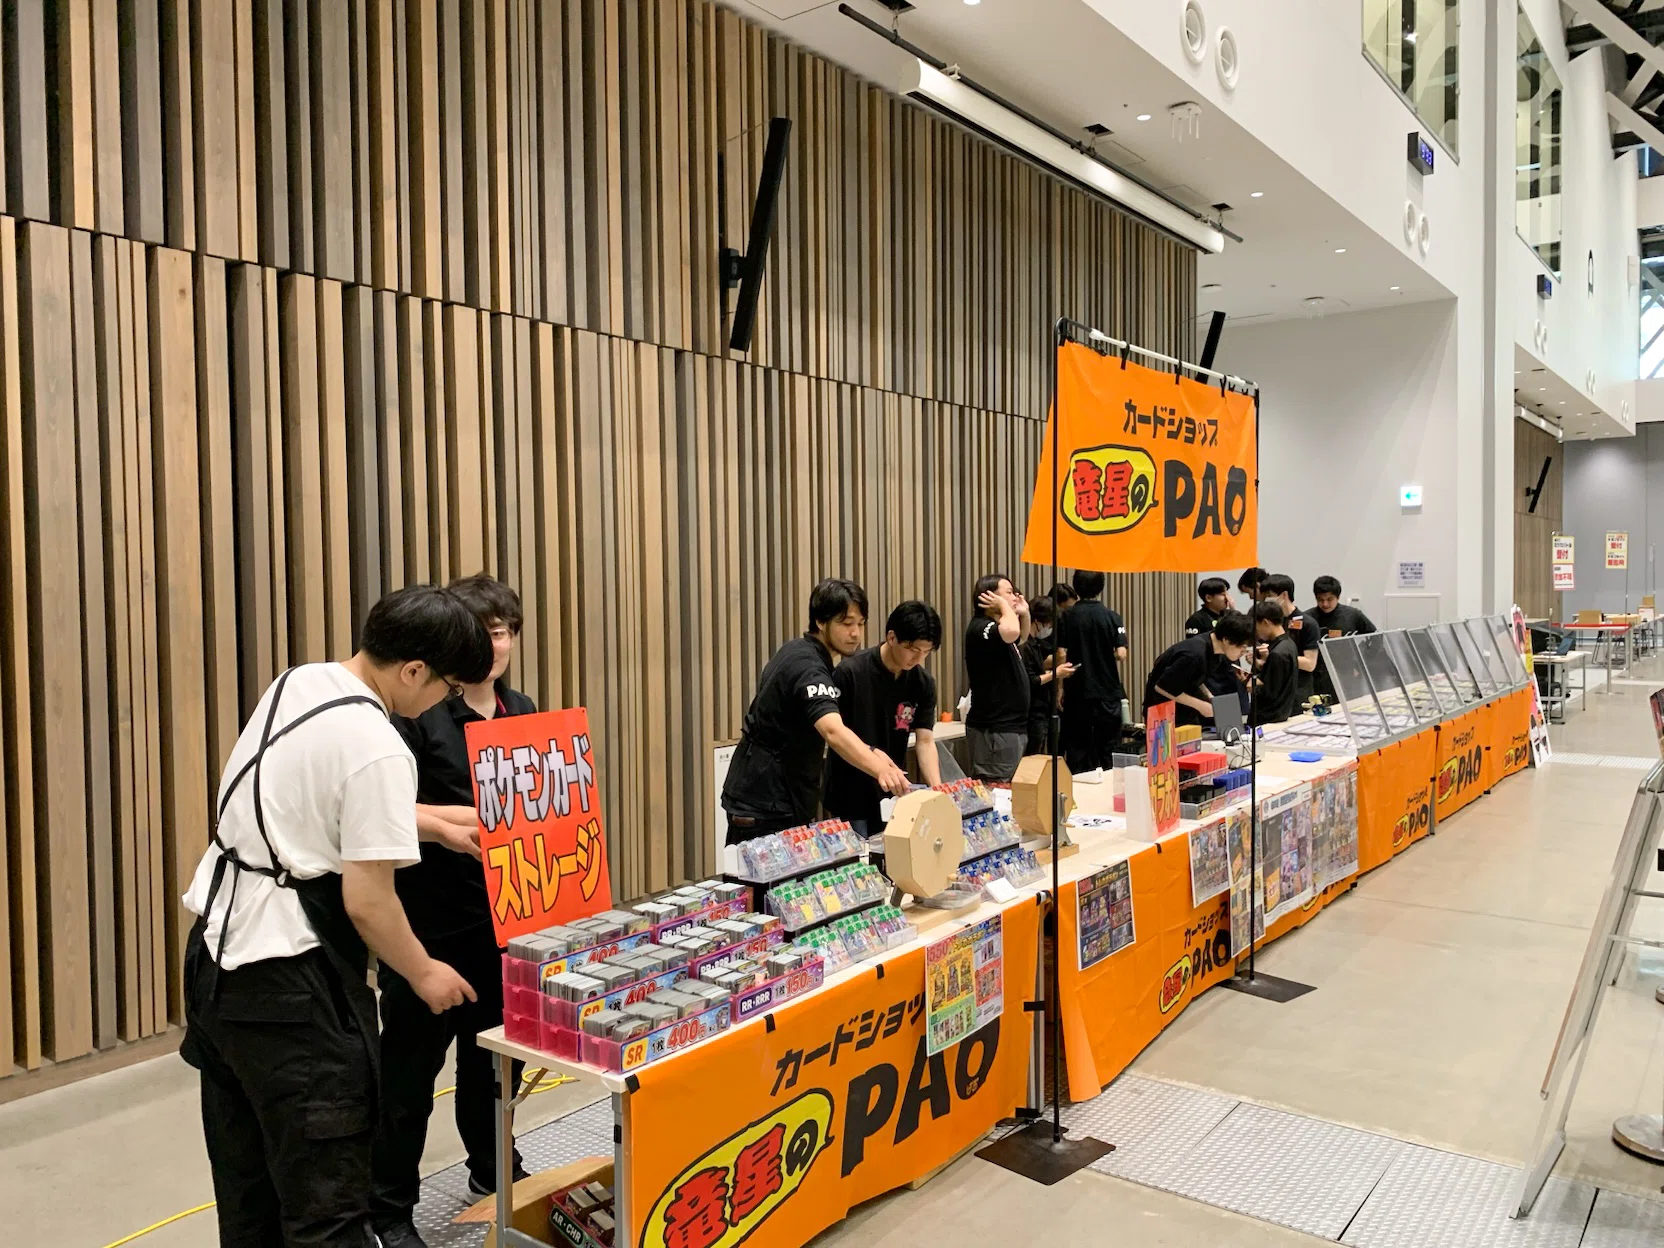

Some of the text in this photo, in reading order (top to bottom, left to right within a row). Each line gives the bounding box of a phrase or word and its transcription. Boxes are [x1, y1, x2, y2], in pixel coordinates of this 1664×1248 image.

[1123, 399, 1218, 447] カードショップ
[1072, 459, 1248, 539] 竜星の PAO
[806, 683, 836, 699] PAO
[474, 733, 592, 832] ポケモンカード
[1456, 744, 1482, 795] PAO
[1408, 803, 1429, 838] PAO
[487, 818, 602, 926] ストレージ
[587, 943, 626, 964] 400
[746, 938, 769, 955] 150
[1191, 928, 1232, 989] PAO
[624, 980, 664, 1007] 400
[626, 1043, 645, 1067] SR
[652, 1037, 665, 1055] 1枚
[770, 988, 927, 1096] カードショッ
[663, 1012, 1001, 1248] 竜星の PAO
